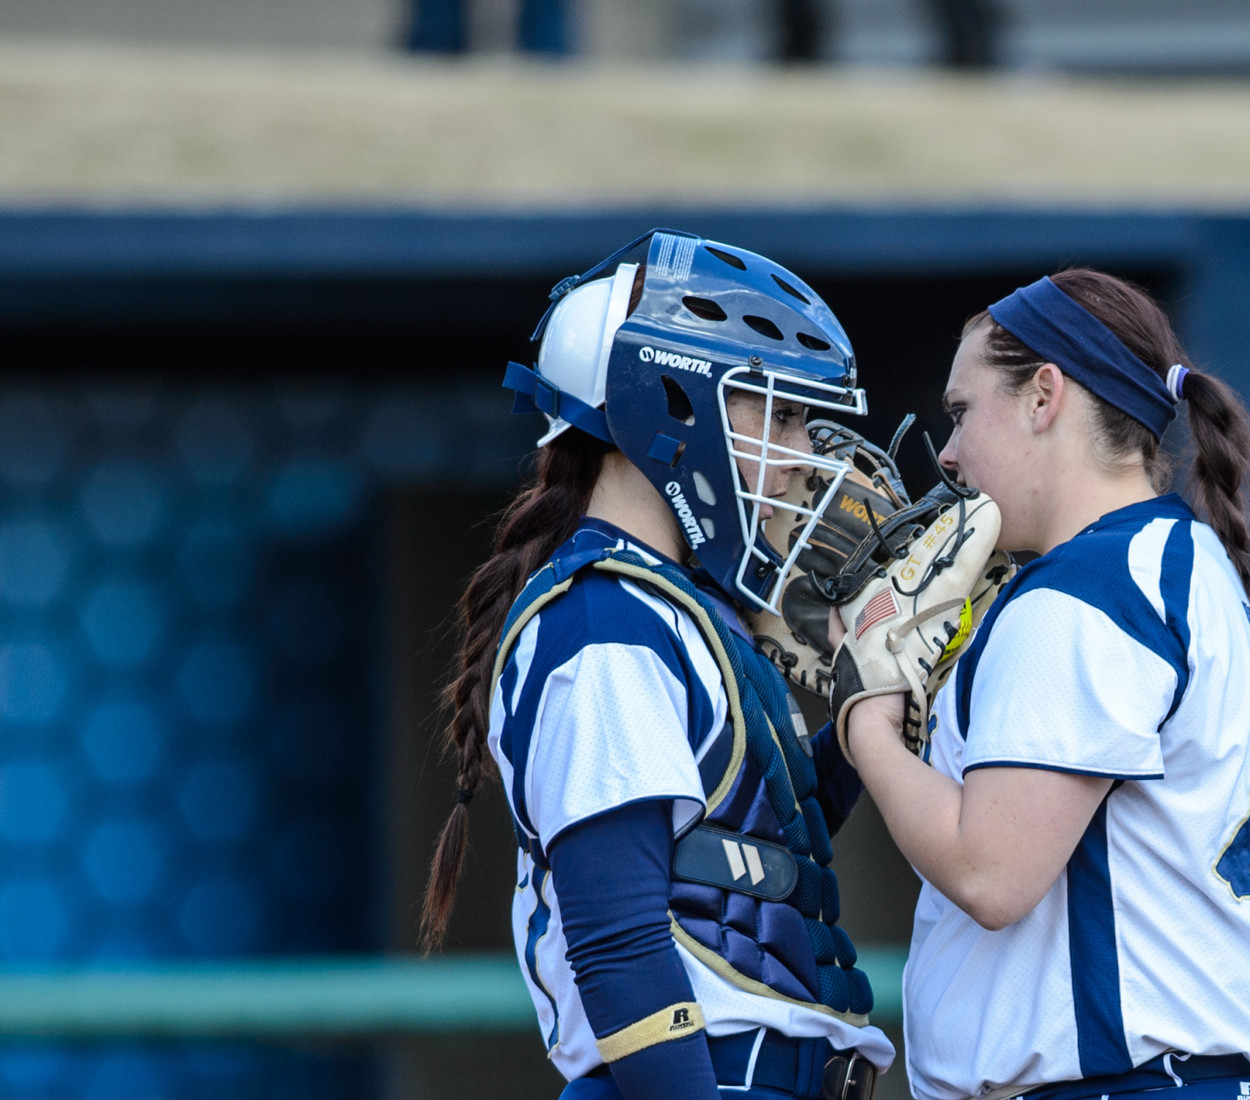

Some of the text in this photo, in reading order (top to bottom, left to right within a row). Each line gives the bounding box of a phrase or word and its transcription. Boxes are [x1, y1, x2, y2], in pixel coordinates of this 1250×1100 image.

[654, 349, 713, 375] WORTH
[671, 493, 706, 544] WORTH
[900, 554, 920, 581] GT
[673, 1007, 689, 1024] R
